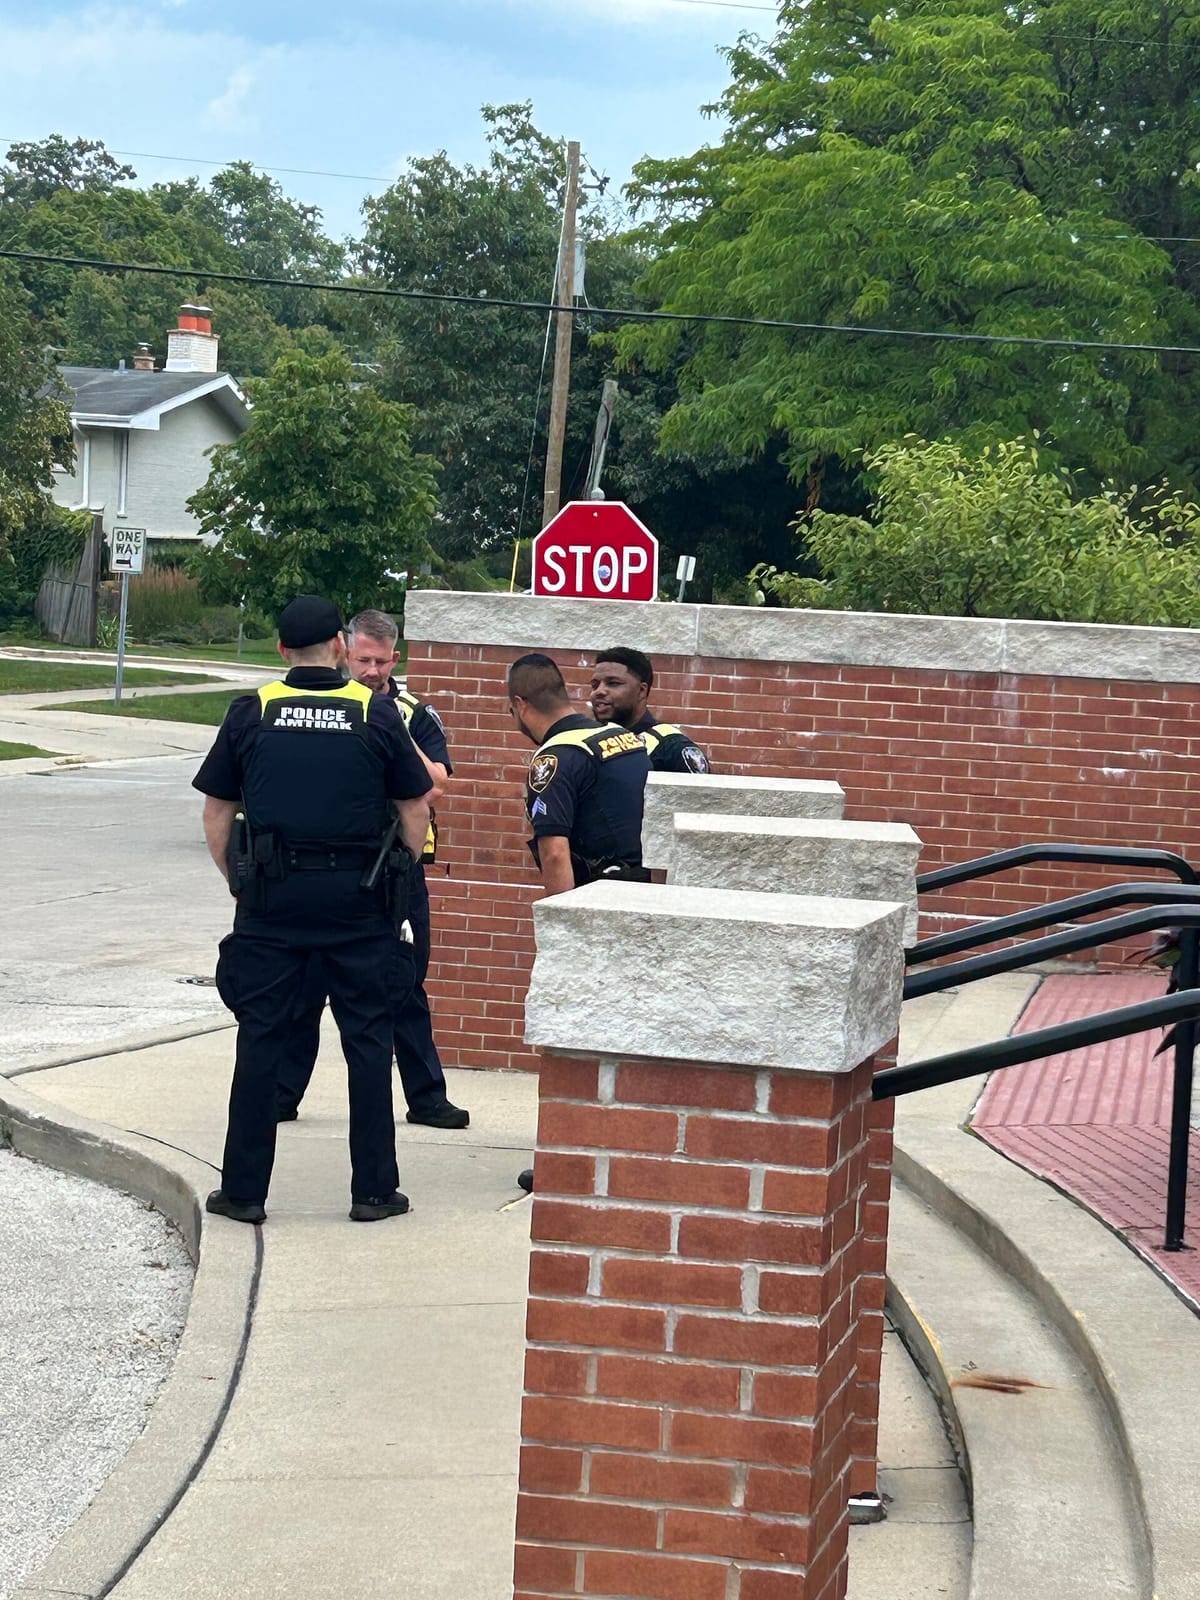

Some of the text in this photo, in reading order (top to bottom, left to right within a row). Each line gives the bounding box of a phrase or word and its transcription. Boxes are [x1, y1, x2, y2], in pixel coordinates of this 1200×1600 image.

[117, 531, 142, 543] ONE
[116, 543, 142, 555] WAY
[541, 545, 648, 593] STOP
[280, 707, 346, 721] POLICE
